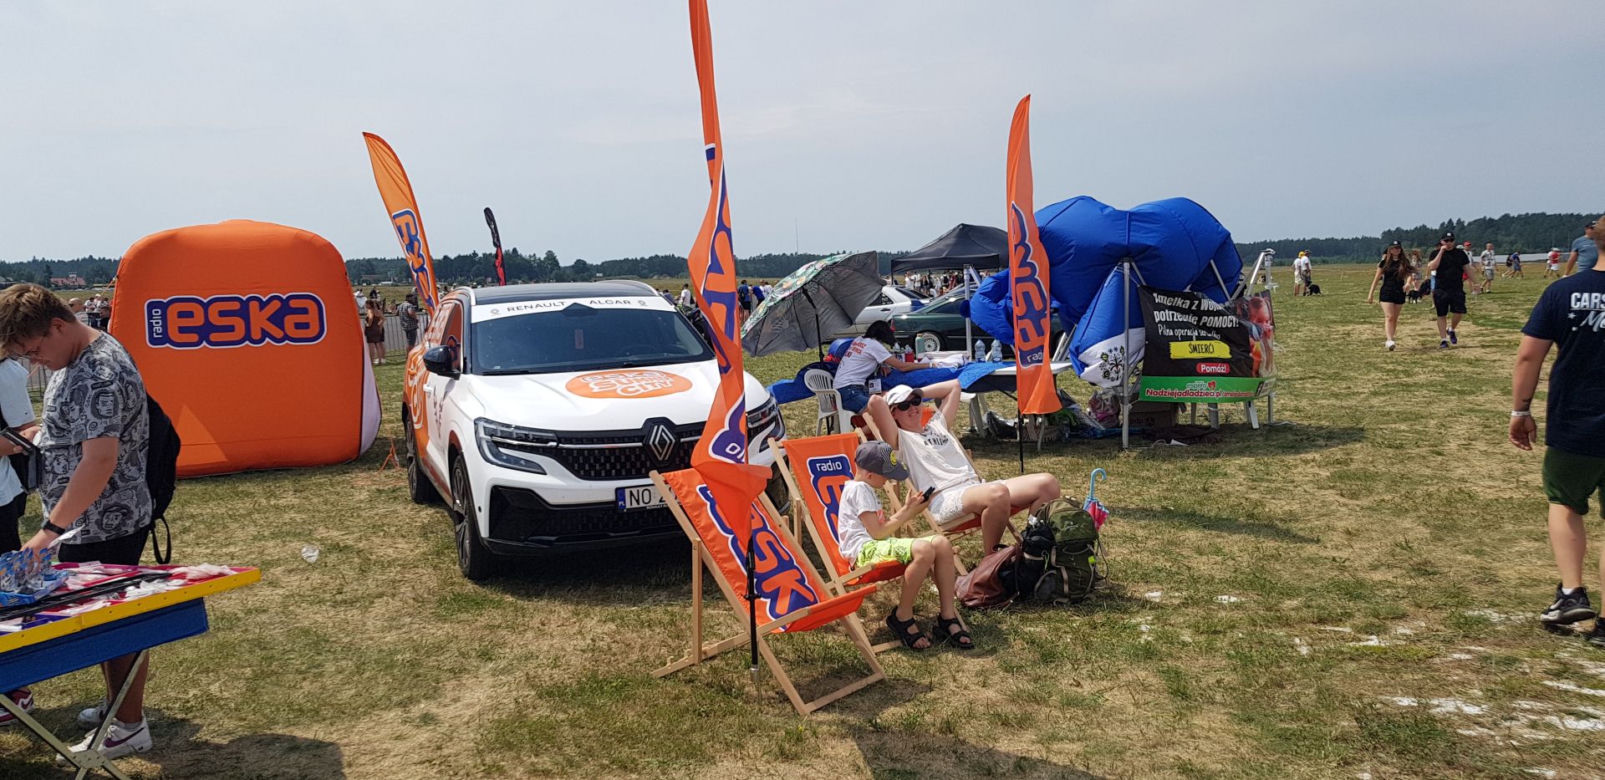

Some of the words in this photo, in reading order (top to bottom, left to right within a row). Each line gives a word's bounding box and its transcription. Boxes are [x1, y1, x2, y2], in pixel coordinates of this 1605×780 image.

[506, 301, 566, 312] RENAULT
[150, 308, 163, 338] radio
[166, 299, 320, 343] eska
[816, 461, 842, 472] radio
